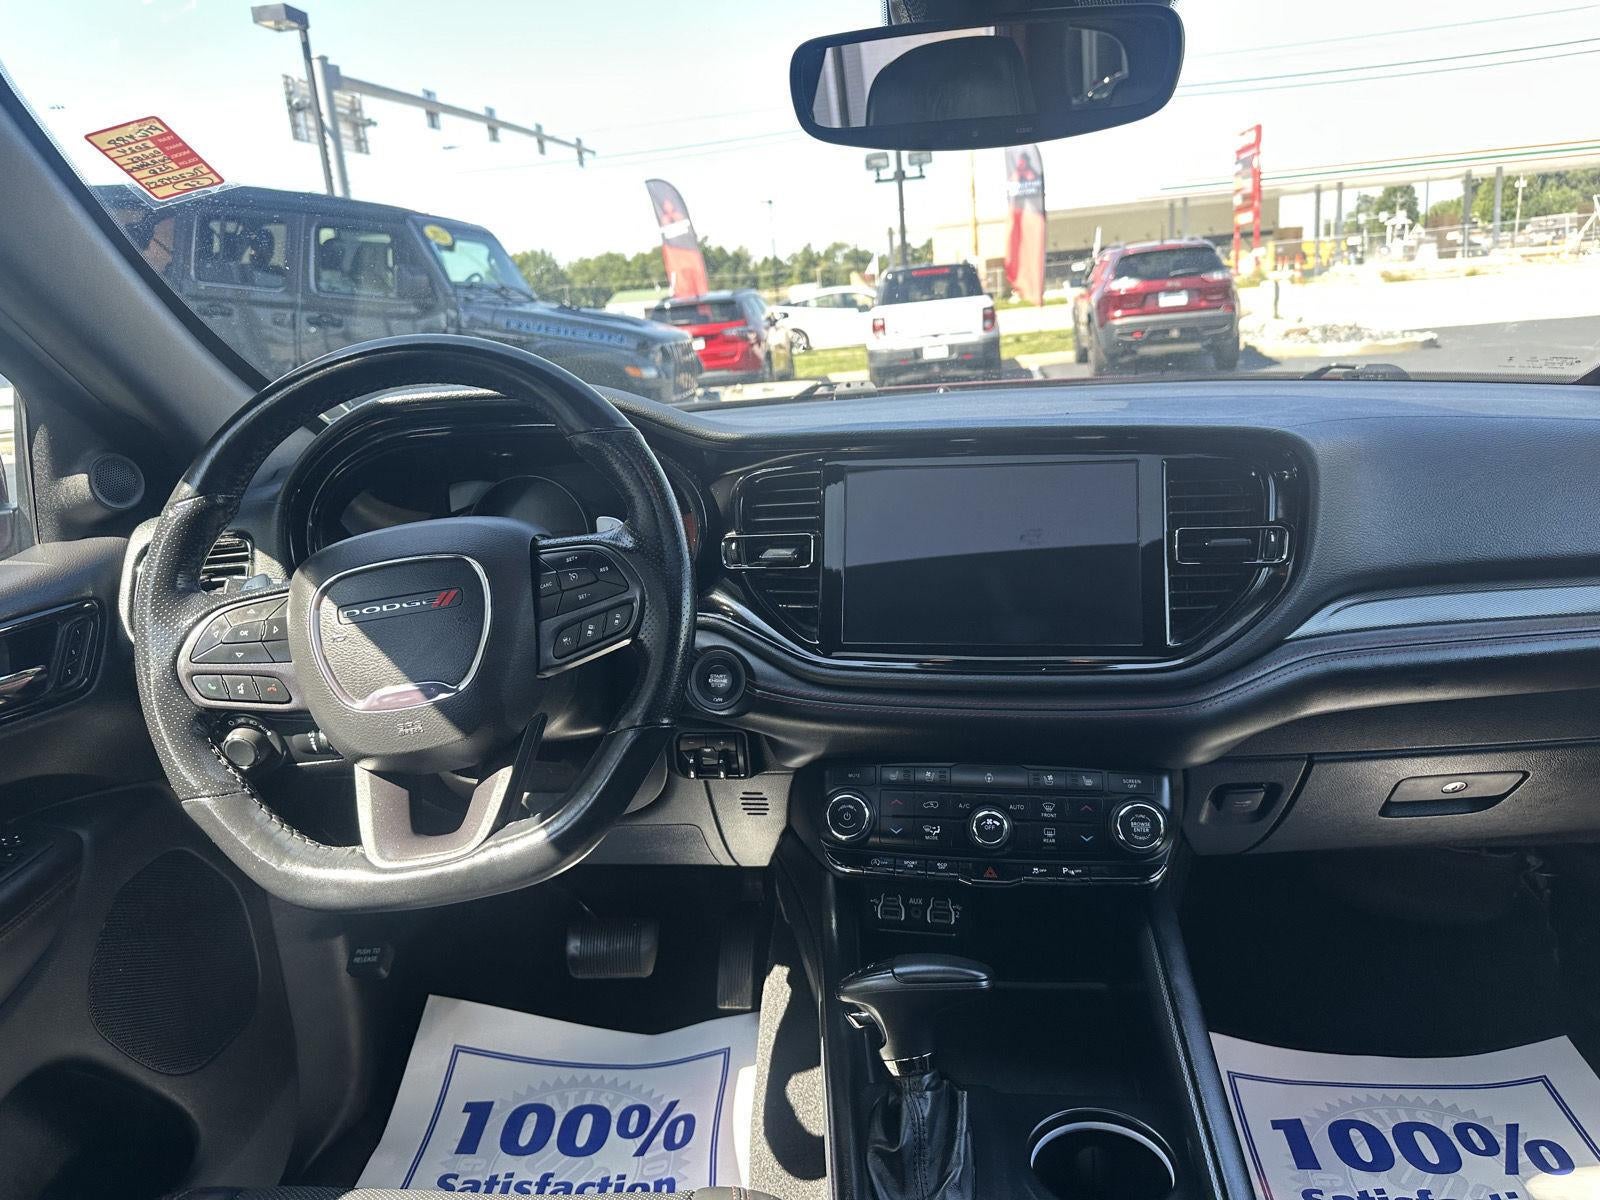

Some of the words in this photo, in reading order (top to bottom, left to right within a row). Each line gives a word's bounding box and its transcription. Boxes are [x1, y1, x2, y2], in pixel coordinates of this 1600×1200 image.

[343, 597, 439, 619] DODGE
[353, 956, 378, 964] RELEASE
[454, 1099, 696, 1157] 100%
[1270, 1117, 1575, 1175] 100%
